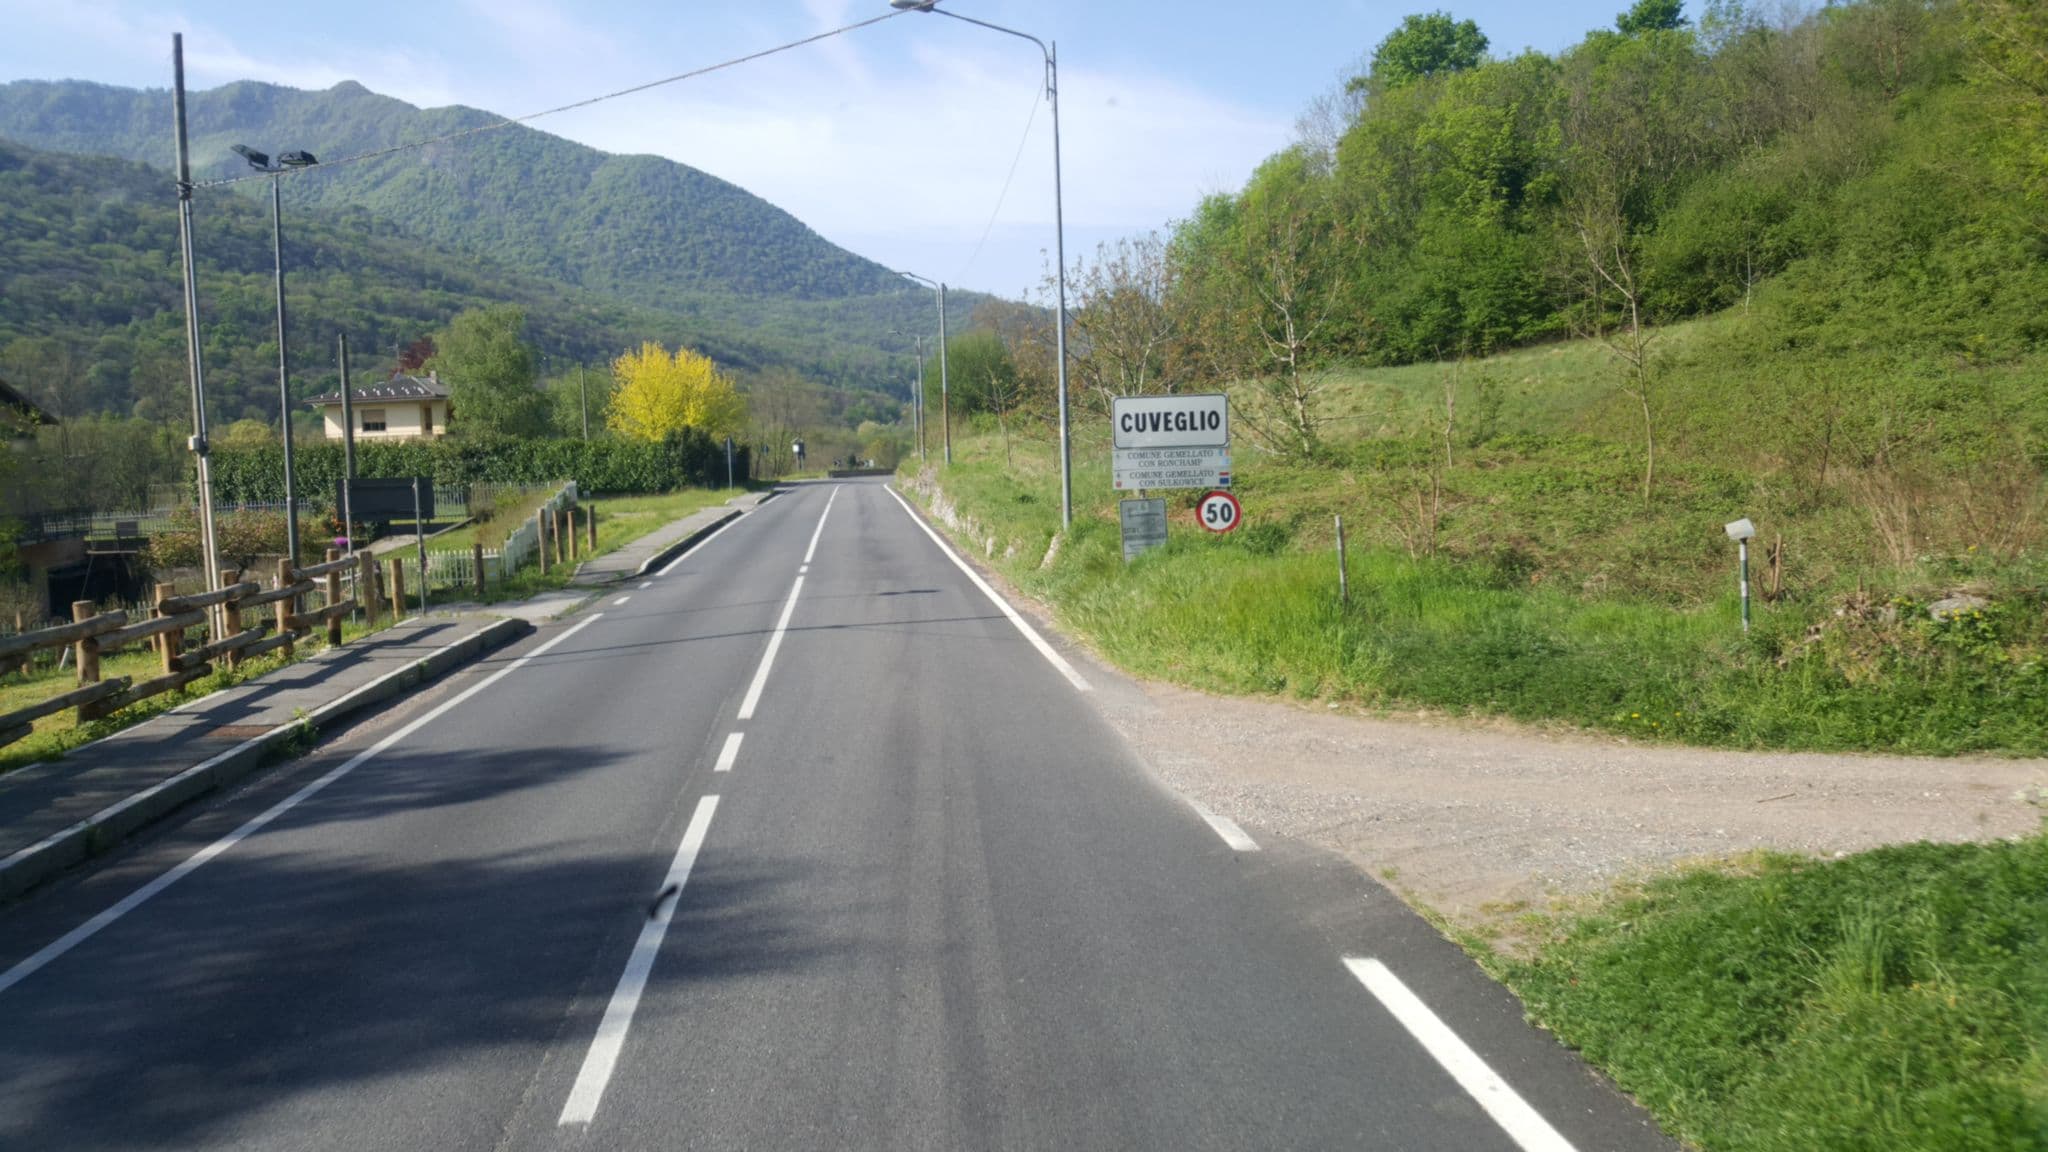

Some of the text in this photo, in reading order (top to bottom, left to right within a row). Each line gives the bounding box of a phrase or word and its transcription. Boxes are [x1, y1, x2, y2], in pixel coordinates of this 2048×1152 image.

[1121, 410, 1220, 432] CUVEGLIO
[1127, 449, 1214, 460] COMUNE GEMELLATO
[1138, 459, 1203, 468] CON RONCHAMP
[1129, 470, 1215, 480] COMUNE GEMELLATO
[1139, 479, 1157, 487] CON
[1206, 503, 1233, 524] 50
